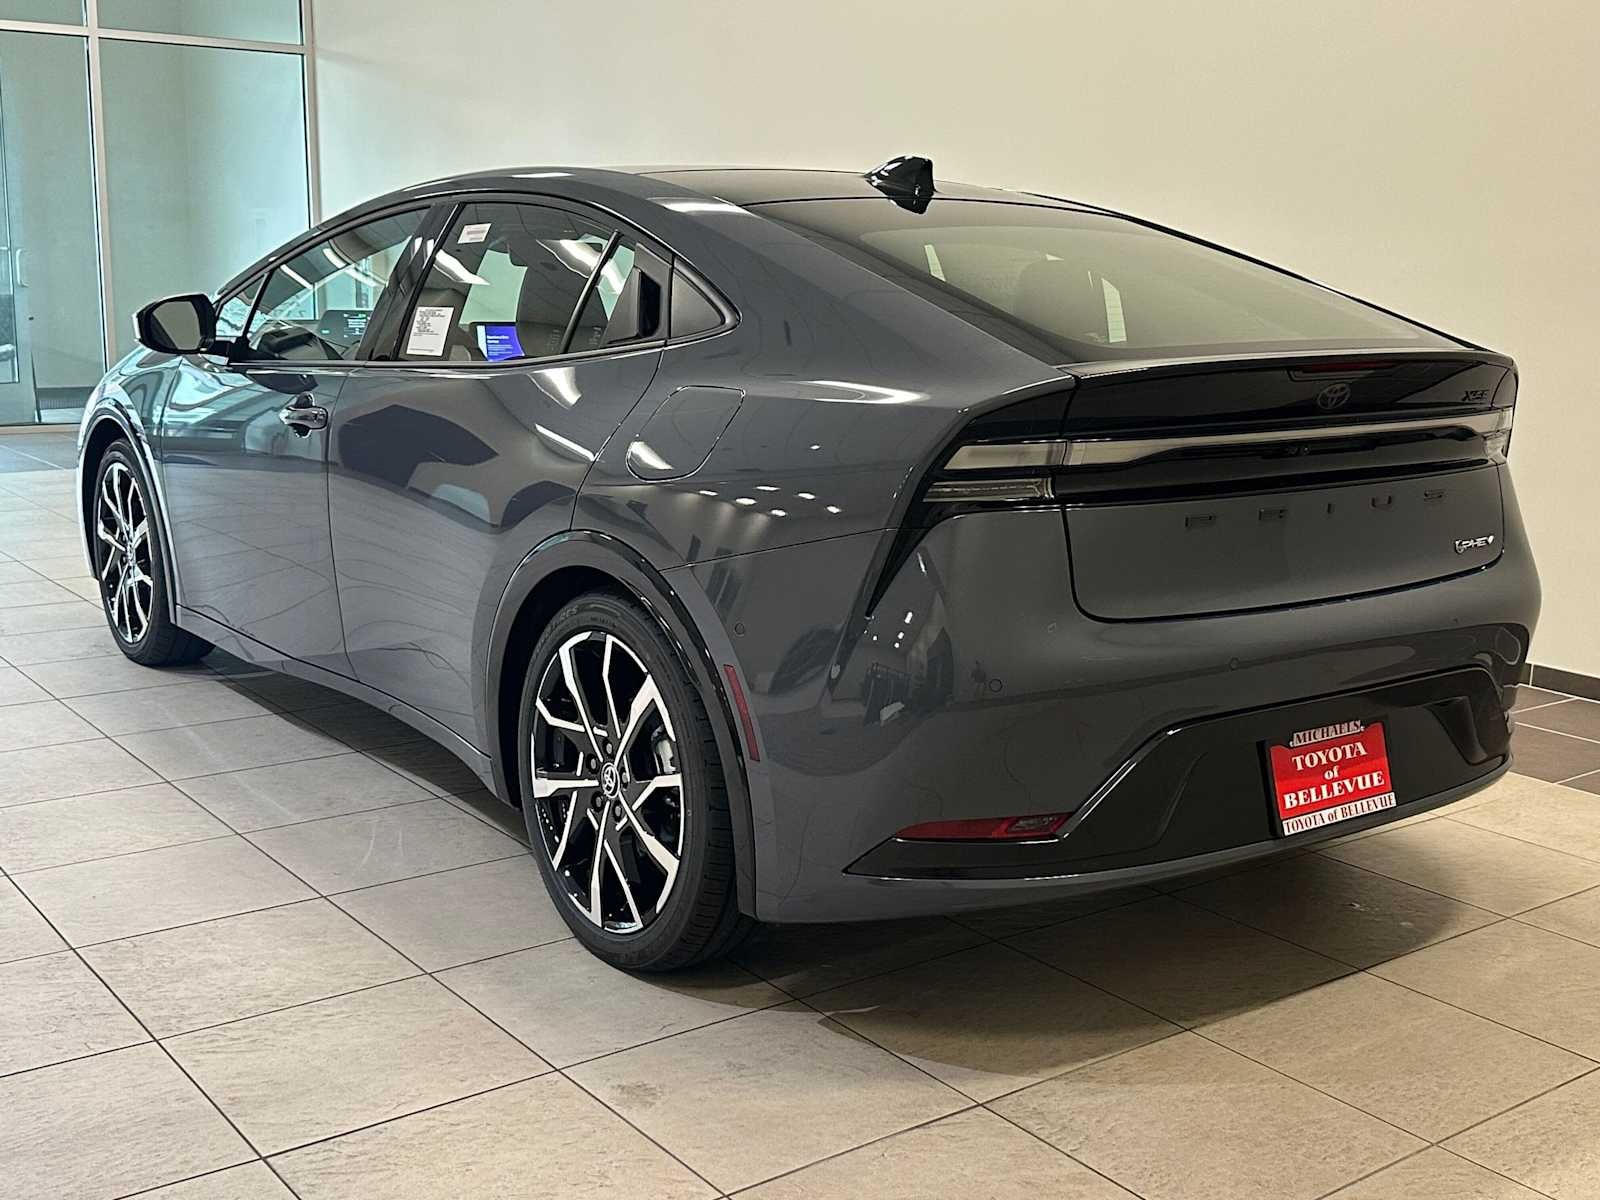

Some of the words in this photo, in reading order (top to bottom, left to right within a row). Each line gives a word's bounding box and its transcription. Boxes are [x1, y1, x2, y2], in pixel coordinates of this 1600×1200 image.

[1291, 741, 1368, 771] TOYOTA
[1323, 765, 1340, 780] of
[1283, 770, 1385, 810] BELLEVUE
[1284, 811, 1326, 834] TOYOTA
[1327, 808, 1338, 822] of
[1340, 793, 1395, 818] BELLEVUE
